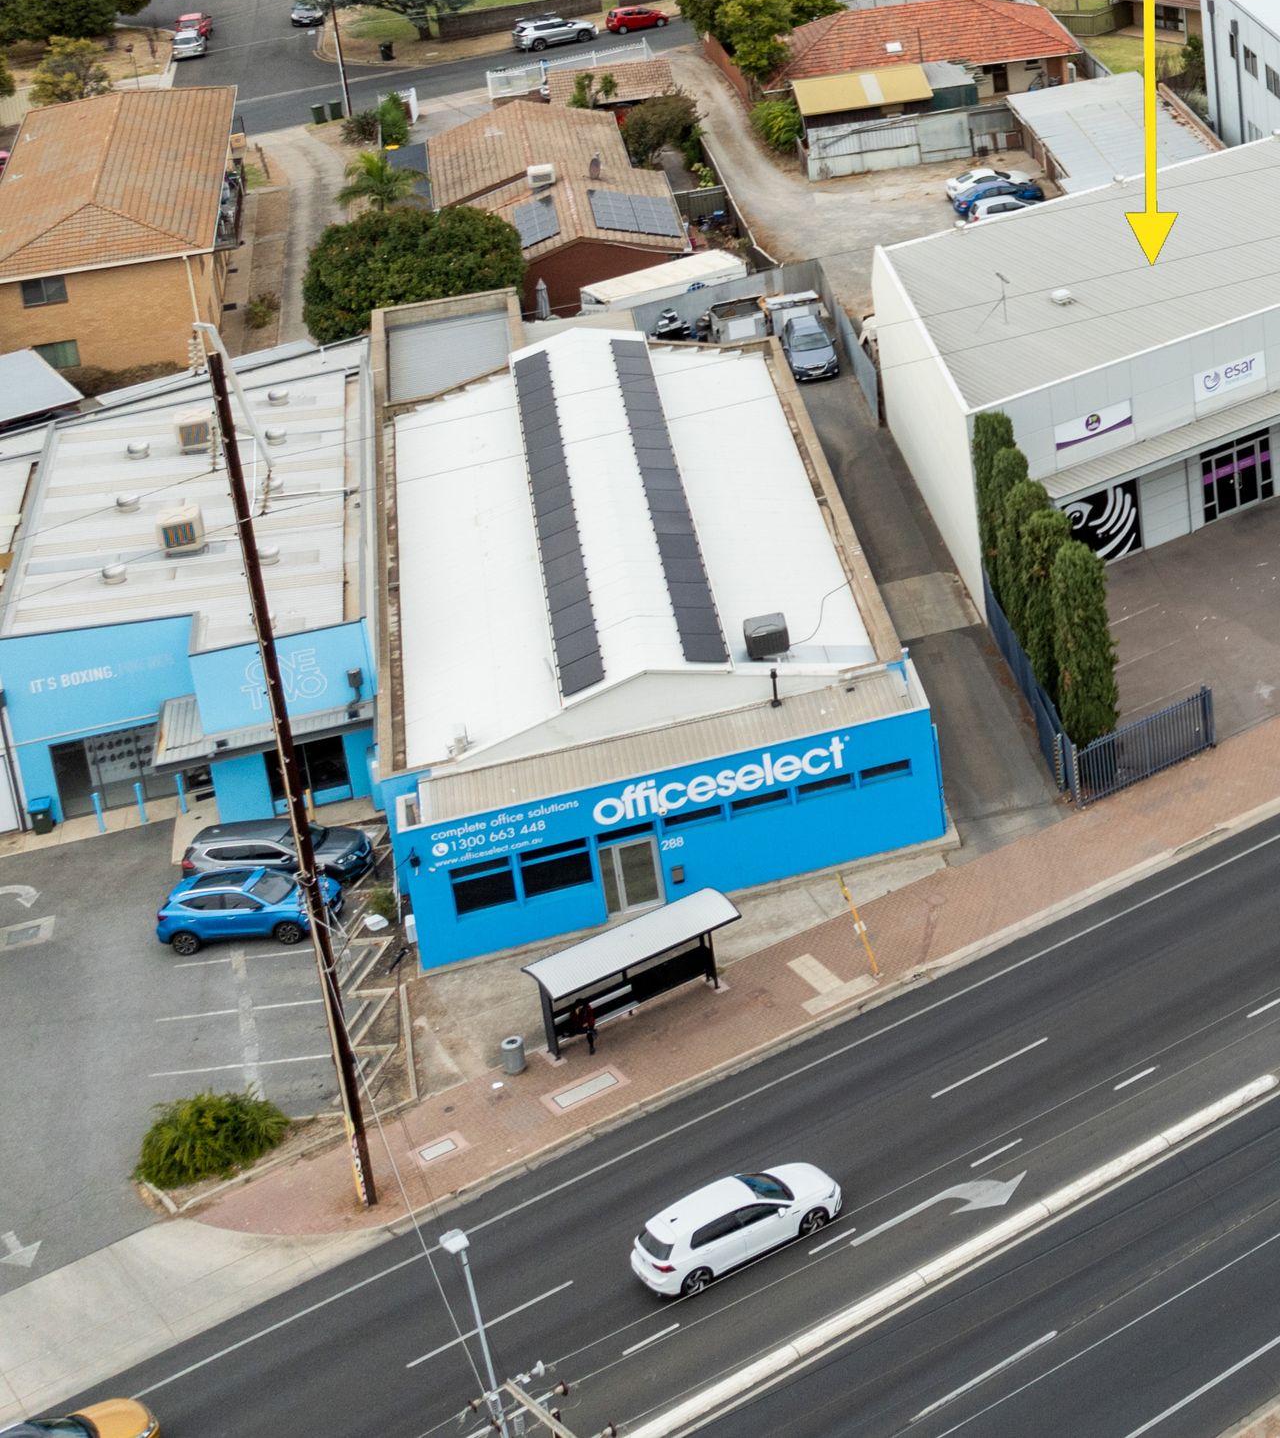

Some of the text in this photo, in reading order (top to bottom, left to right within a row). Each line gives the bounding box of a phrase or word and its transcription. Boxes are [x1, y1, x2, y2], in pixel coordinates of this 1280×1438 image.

[1224, 358, 1255, 379] esar
[592, 736, 845, 826] officeselect
[430, 799, 579, 841] complete office solutions
[450, 819, 546, 852] 1300 663 448
[434, 836, 543, 868] www.officeselect.com.au
[661, 836, 684, 851] 288
